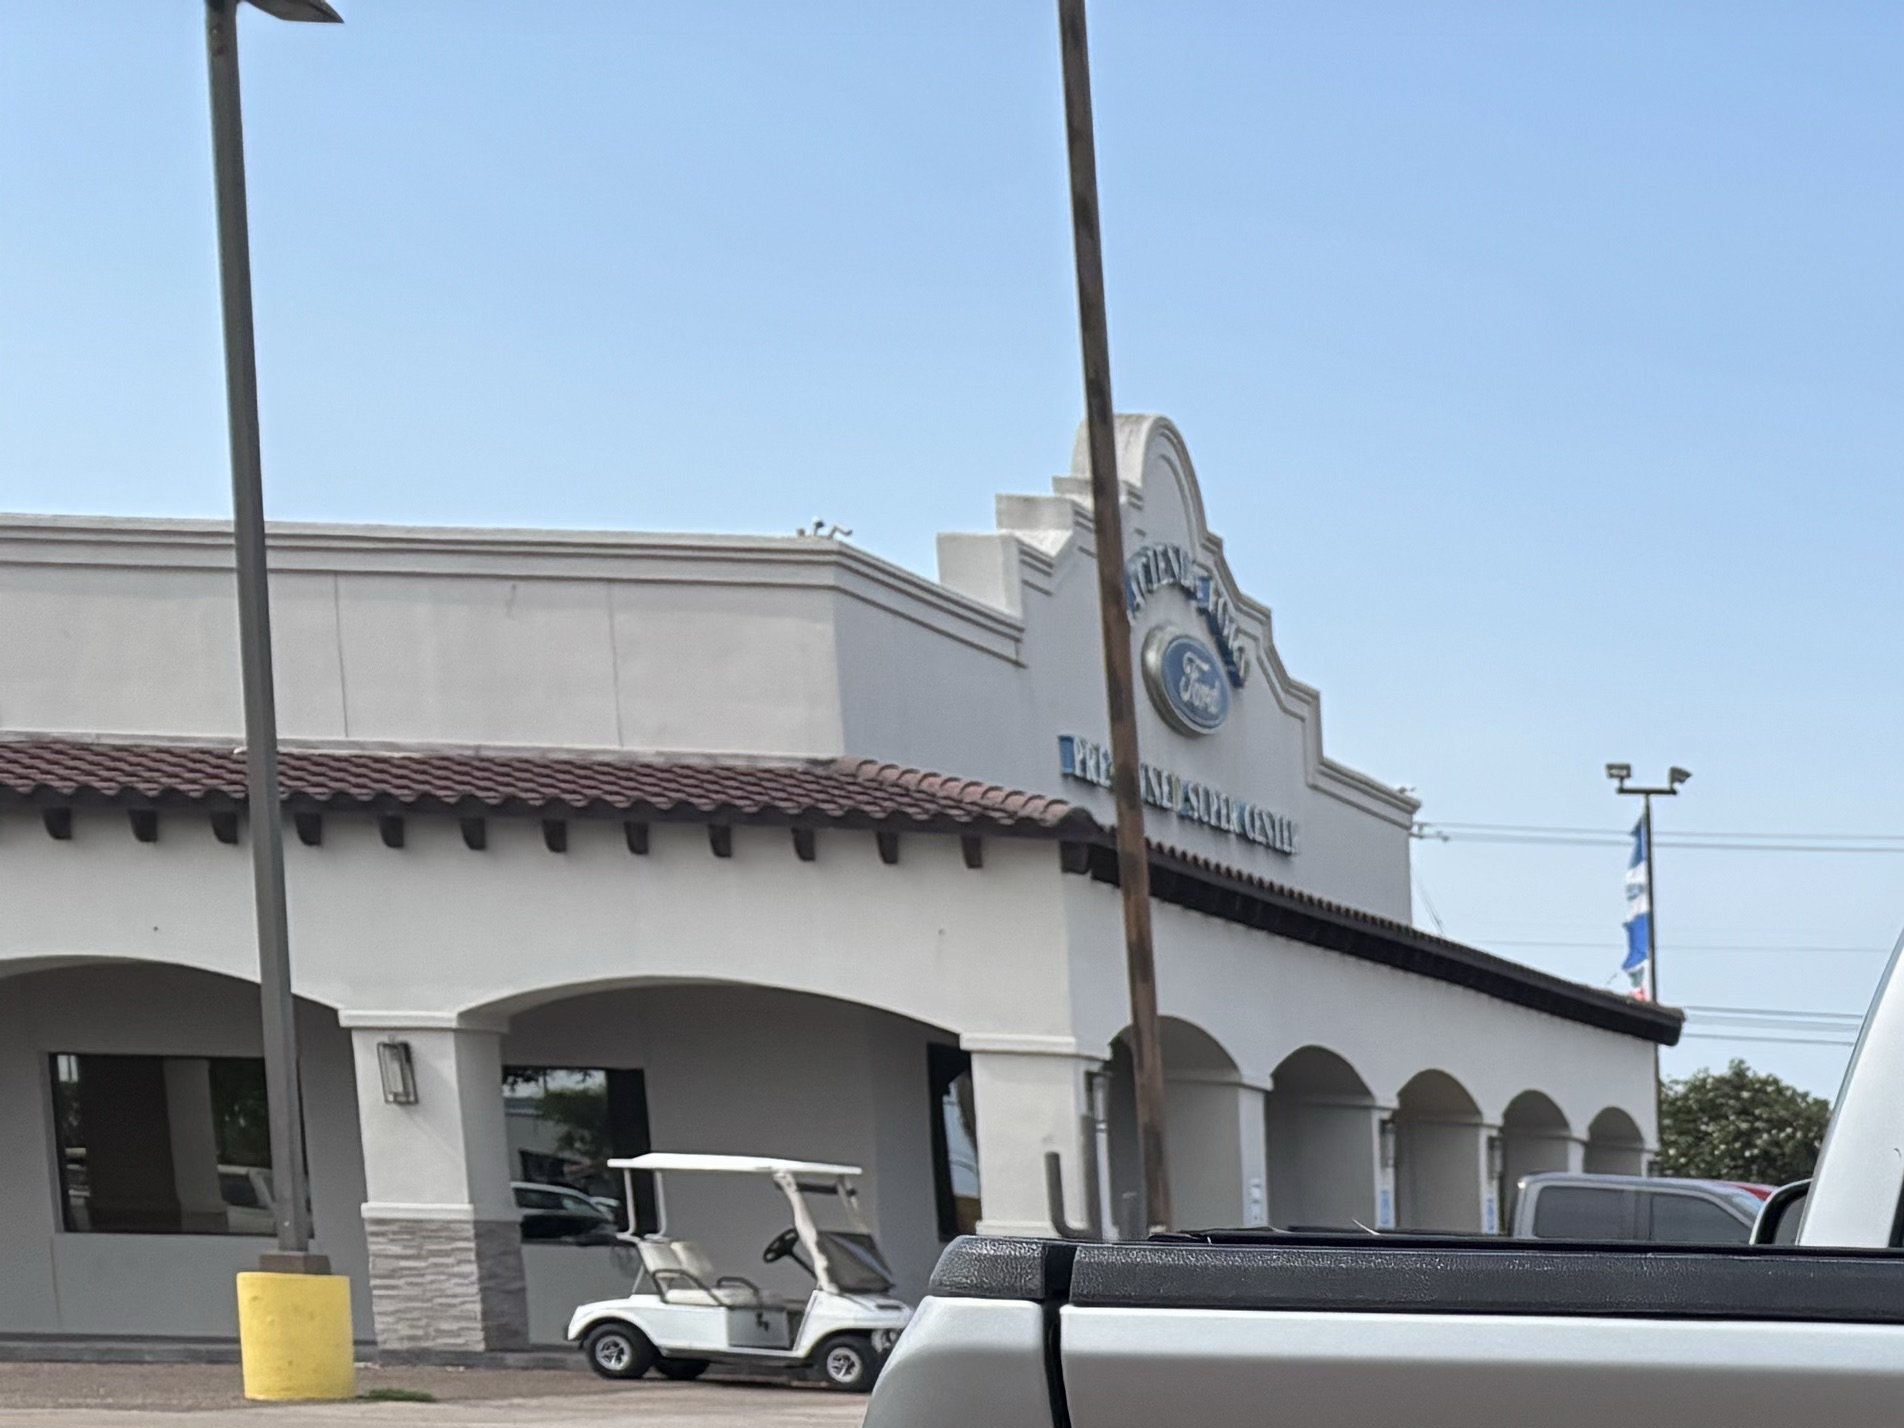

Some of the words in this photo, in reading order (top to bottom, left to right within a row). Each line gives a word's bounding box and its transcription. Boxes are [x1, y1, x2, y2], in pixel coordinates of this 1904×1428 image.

[1179, 651, 1219, 715] Ford
[1186, 780, 1240, 836] SUPER
[1242, 802, 1297, 857] CENTER
